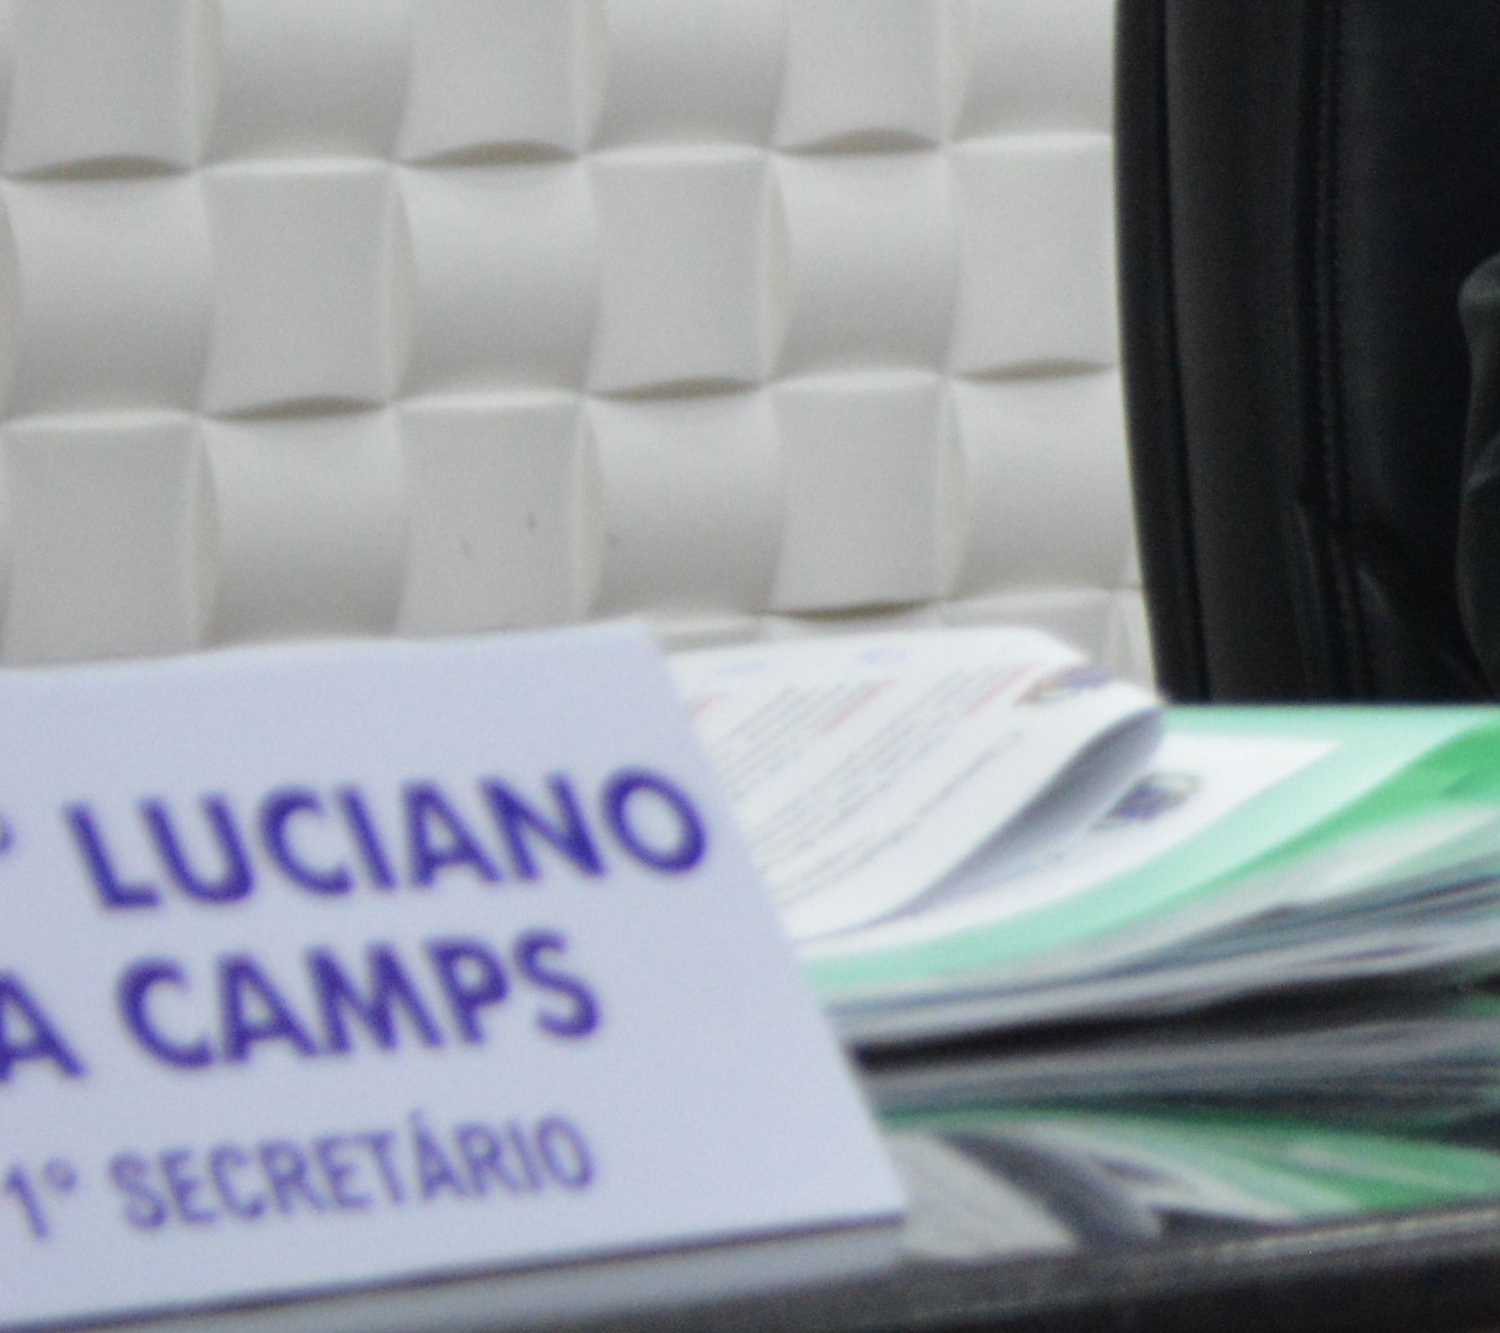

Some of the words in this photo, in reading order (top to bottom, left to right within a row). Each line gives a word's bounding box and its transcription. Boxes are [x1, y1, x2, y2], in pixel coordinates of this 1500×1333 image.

[63, 763, 709, 912] LUCIANO
[115, 929, 602, 1071] CAMPS
[107, 1109, 597, 1231] SECRETÁRIO
